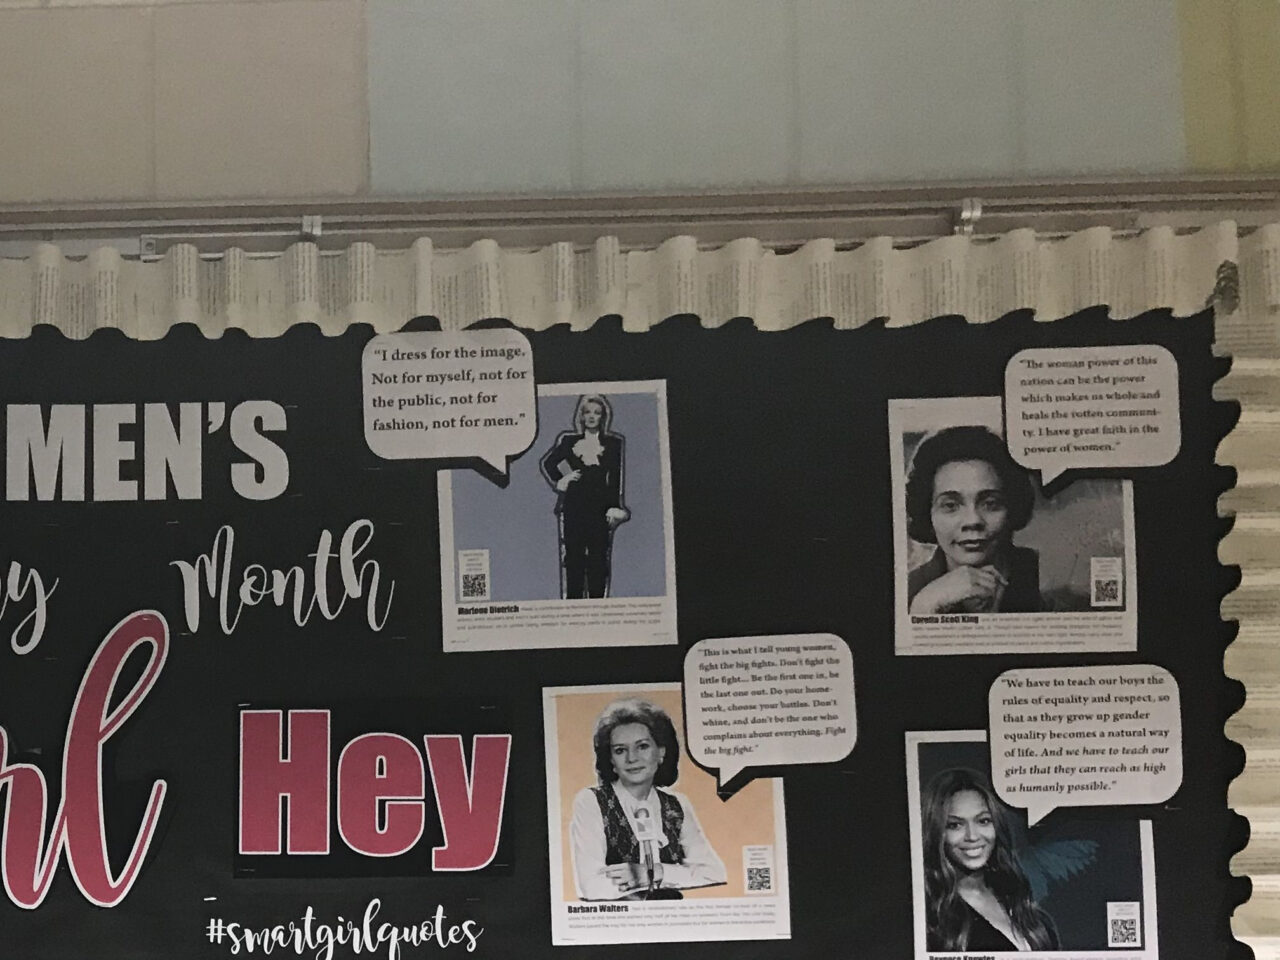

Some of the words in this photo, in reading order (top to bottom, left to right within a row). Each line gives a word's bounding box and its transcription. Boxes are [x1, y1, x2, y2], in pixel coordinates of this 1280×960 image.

[391, 348, 427, 361] dress
[430, 346, 451, 359] for
[454, 346, 477, 358] the
[480, 346, 525, 360] image.
[170, 519, 394, 634] Month
[961, 615, 979, 624] King
[1003, 730, 1047, 742] equality
[1049, 729, 1096, 739] becomes
[1107, 727, 1146, 737] natural
[1148, 729, 1169, 738] way
[239, 709, 511, 871] Hey
[568, 905, 597, 913] Barbara
[599, 904, 629, 912] Walters
